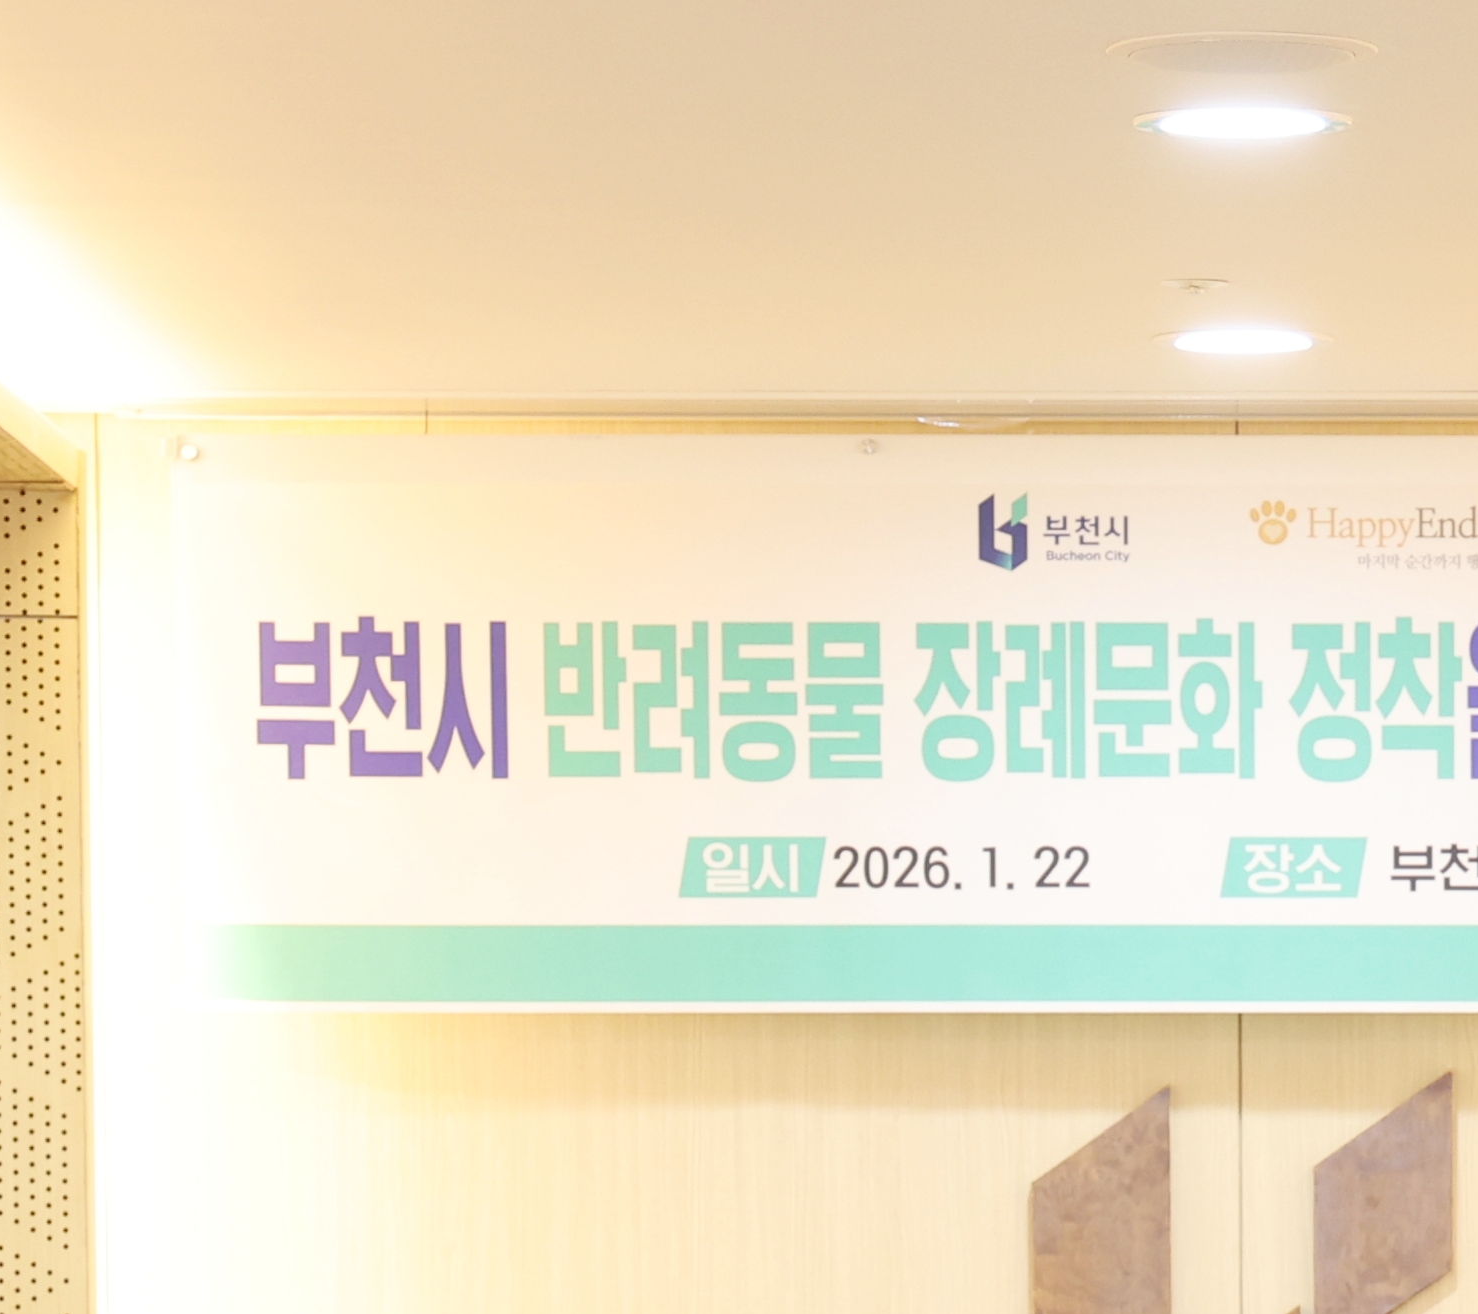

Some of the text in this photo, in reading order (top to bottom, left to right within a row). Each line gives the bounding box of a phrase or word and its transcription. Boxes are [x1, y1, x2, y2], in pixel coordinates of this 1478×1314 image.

[1042, 514, 1129, 546] 부천시
[1045, 550, 1130, 563] Bucheon City
[1356, 552, 1401, 570] 마지막
[1404, 552, 1462, 570] 순간까지
[257, 615, 509, 781] 부천시
[543, 619, 885, 782] 반려동물
[913, 617, 1263, 782] 장례문화
[701, 840, 801, 894] 일시
[832, 845, 962, 891] 2026.
[1033, 845, 1092, 891] 22
[1241, 840, 1343, 894] 장소
